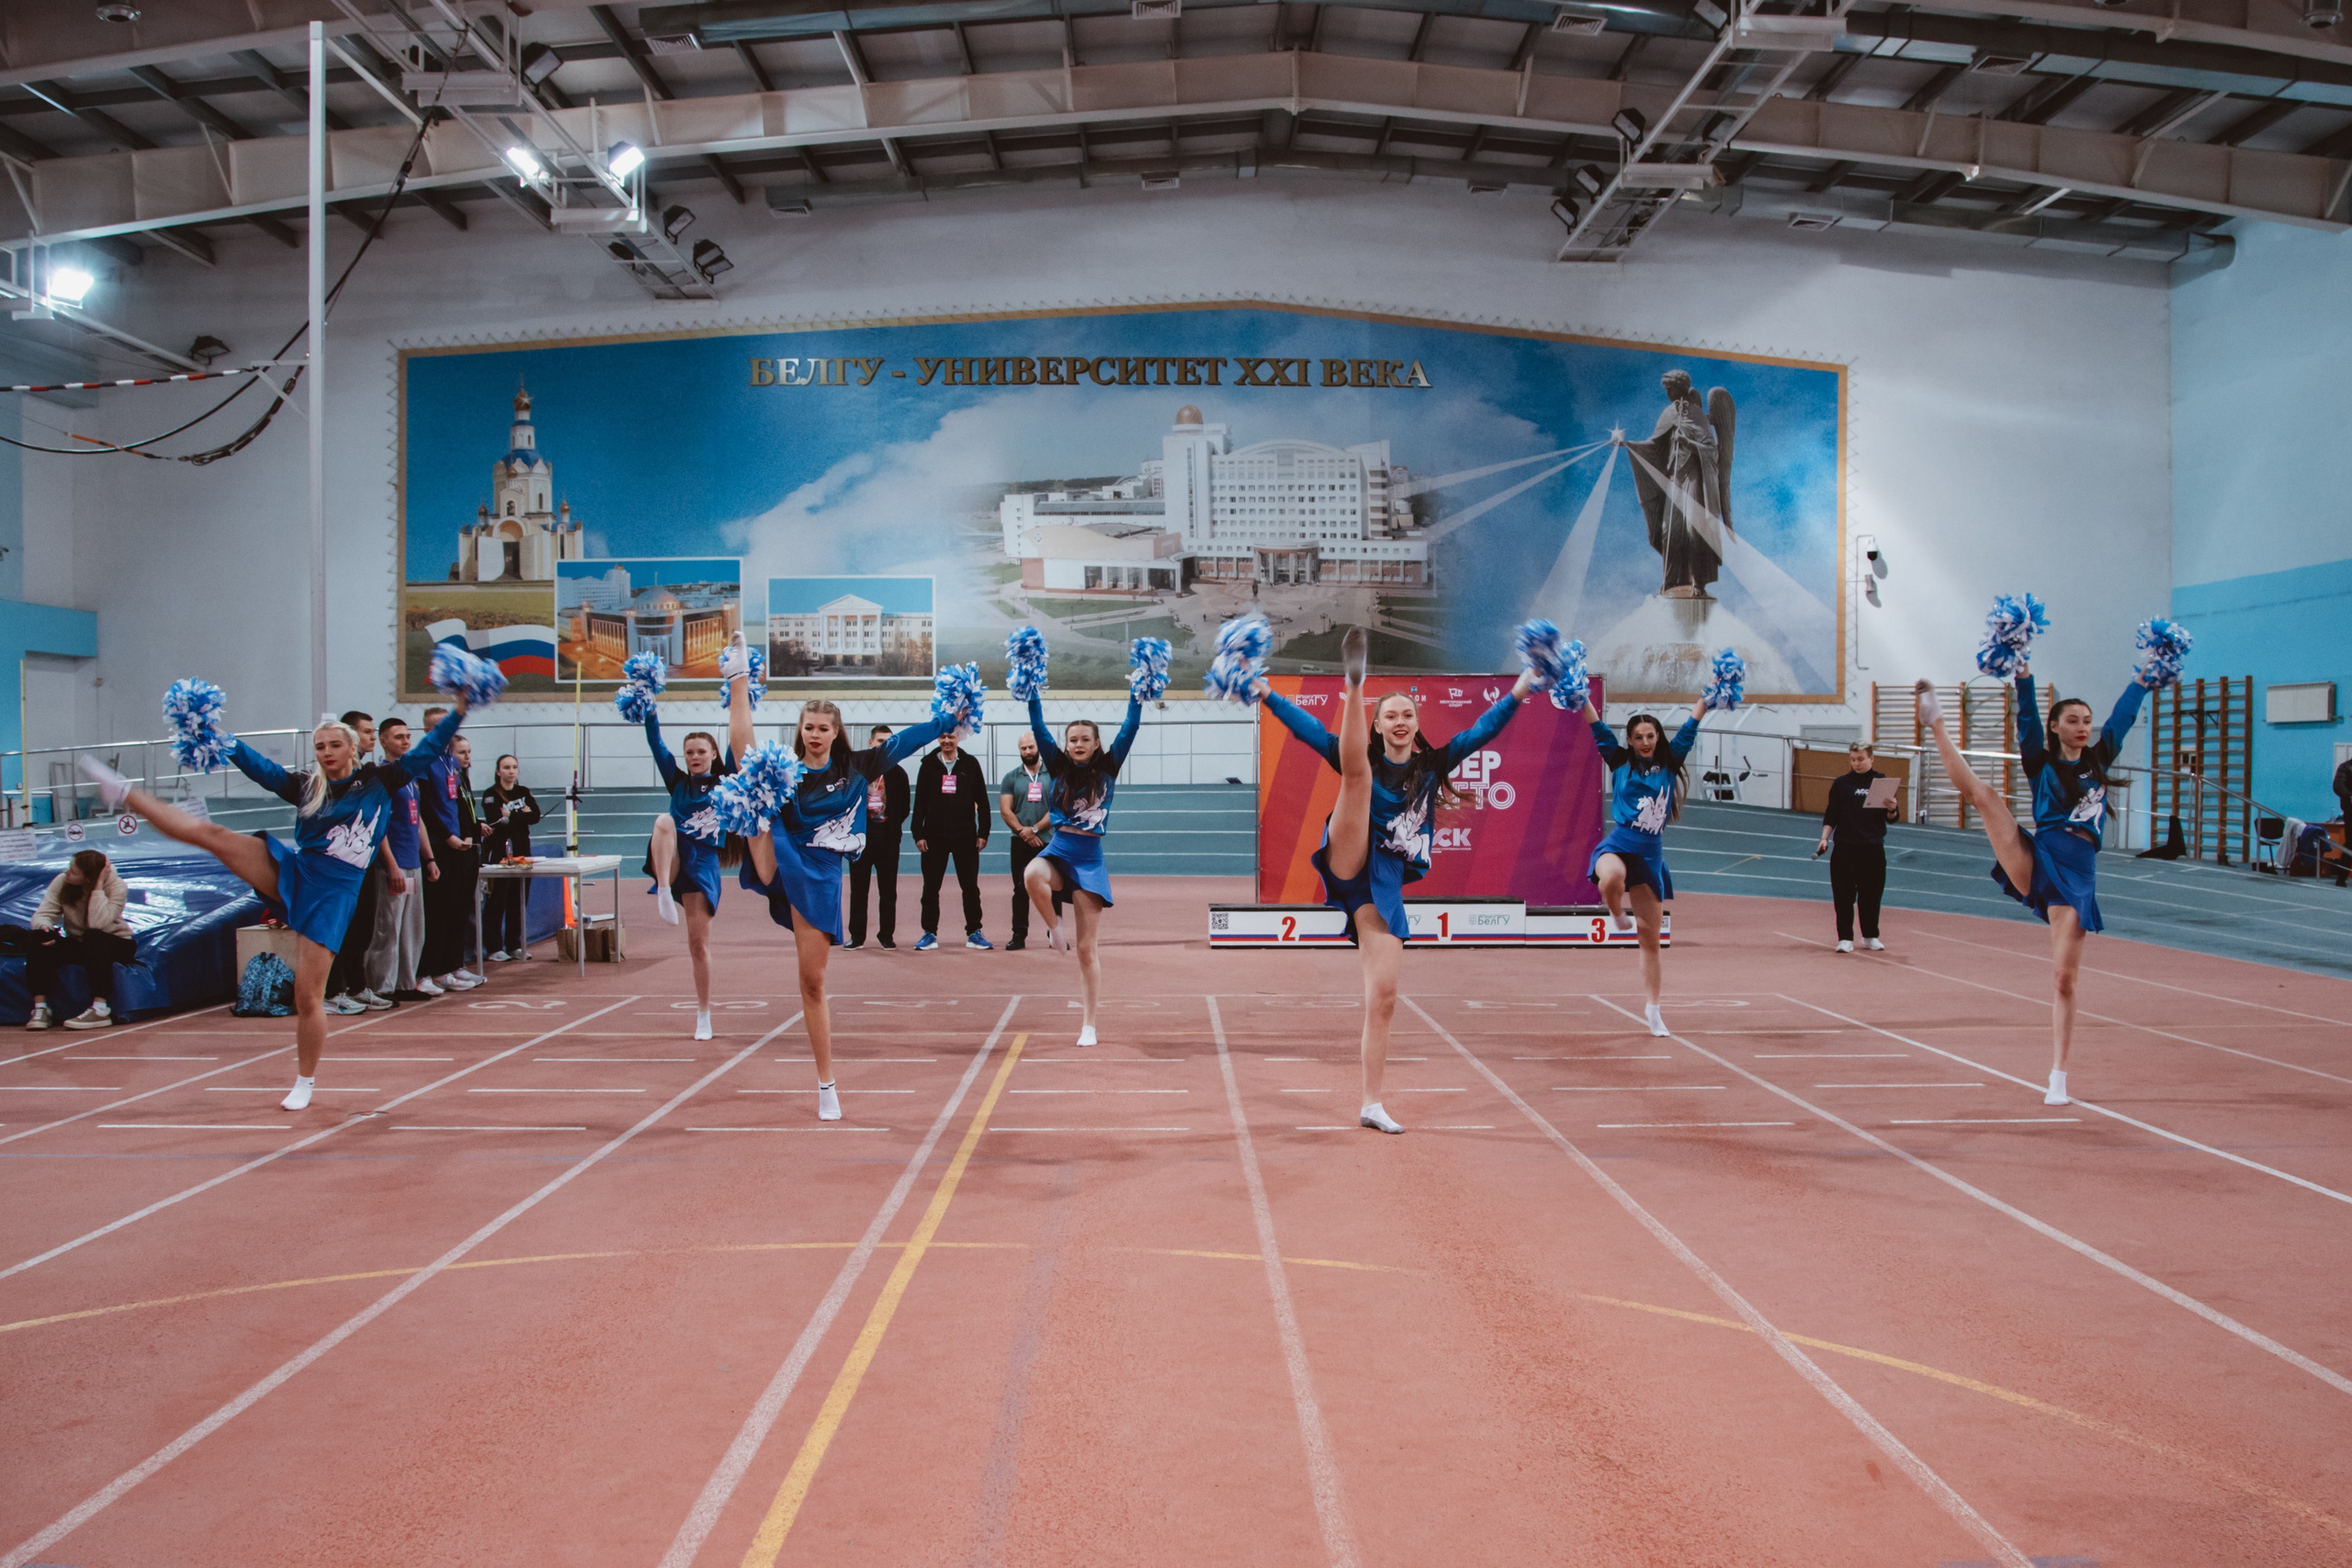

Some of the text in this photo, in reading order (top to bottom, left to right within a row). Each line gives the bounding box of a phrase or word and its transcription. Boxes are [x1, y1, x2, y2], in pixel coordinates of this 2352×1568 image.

[748, 357, 885, 387] БЕЛГУ
[912, 356, 1228, 387] УНИВЕРСИТЕТ
[1233, 357, 1312, 388] XXI
[1319, 358, 1433, 389] ВЕКА
[1282, 916, 1296, 942] 2
[1437, 912, 1449, 938] 1
[1477, 914, 1510, 926] БелГУ
[1590, 918, 1606, 943] 3
